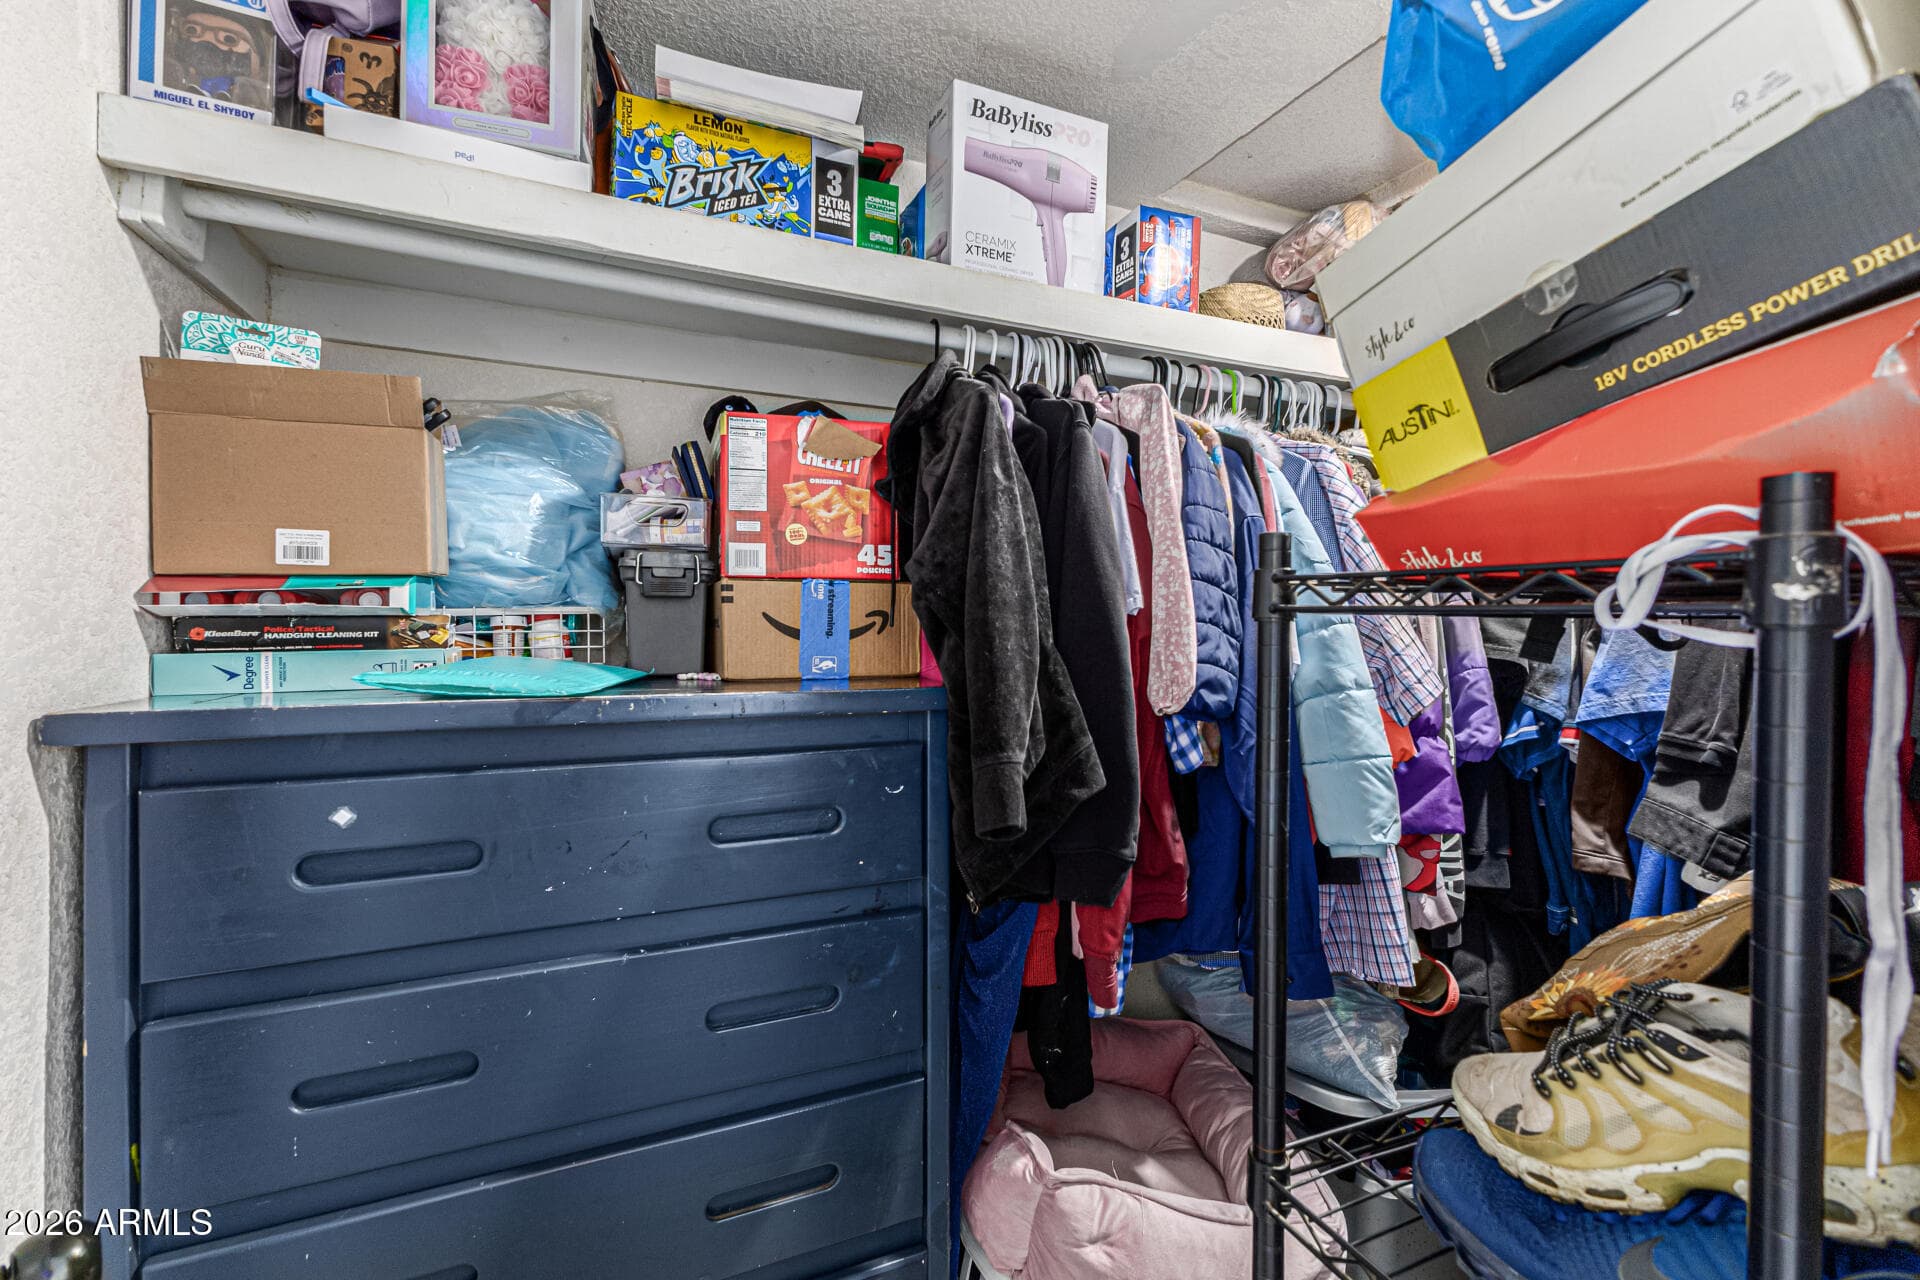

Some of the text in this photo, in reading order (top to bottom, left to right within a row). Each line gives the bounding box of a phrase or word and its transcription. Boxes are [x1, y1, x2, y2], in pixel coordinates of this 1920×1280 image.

[153, 89, 256, 120] MIGUEL EL SHYBOY
[625, 97, 633, 138] RECYCLE
[693, 113, 744, 136] LEMON
[970, 98, 1054, 138] BaByliss
[454, 151, 475, 162] iPad
[826, 169, 843, 197] 3
[713, 193, 758, 213] ICED TEA
[818, 194, 851, 212] EXTRA
[817, 207, 851, 222] CANS
[965, 230, 1017, 251] CERAMIX
[1119, 236, 1130, 261] 3
[1115, 257, 1134, 275] EXTRA
[1115, 267, 1134, 283] CANS
[1594, 230, 1920, 391] 18V CORDLESS POWER DRIL
[234, 346, 265, 360] Nanda
[238, 341, 266, 352] Guru
[857, 544, 892, 566] 45
[264, 631, 314, 639] HANDGUN
[243, 656, 257, 690] Degree
